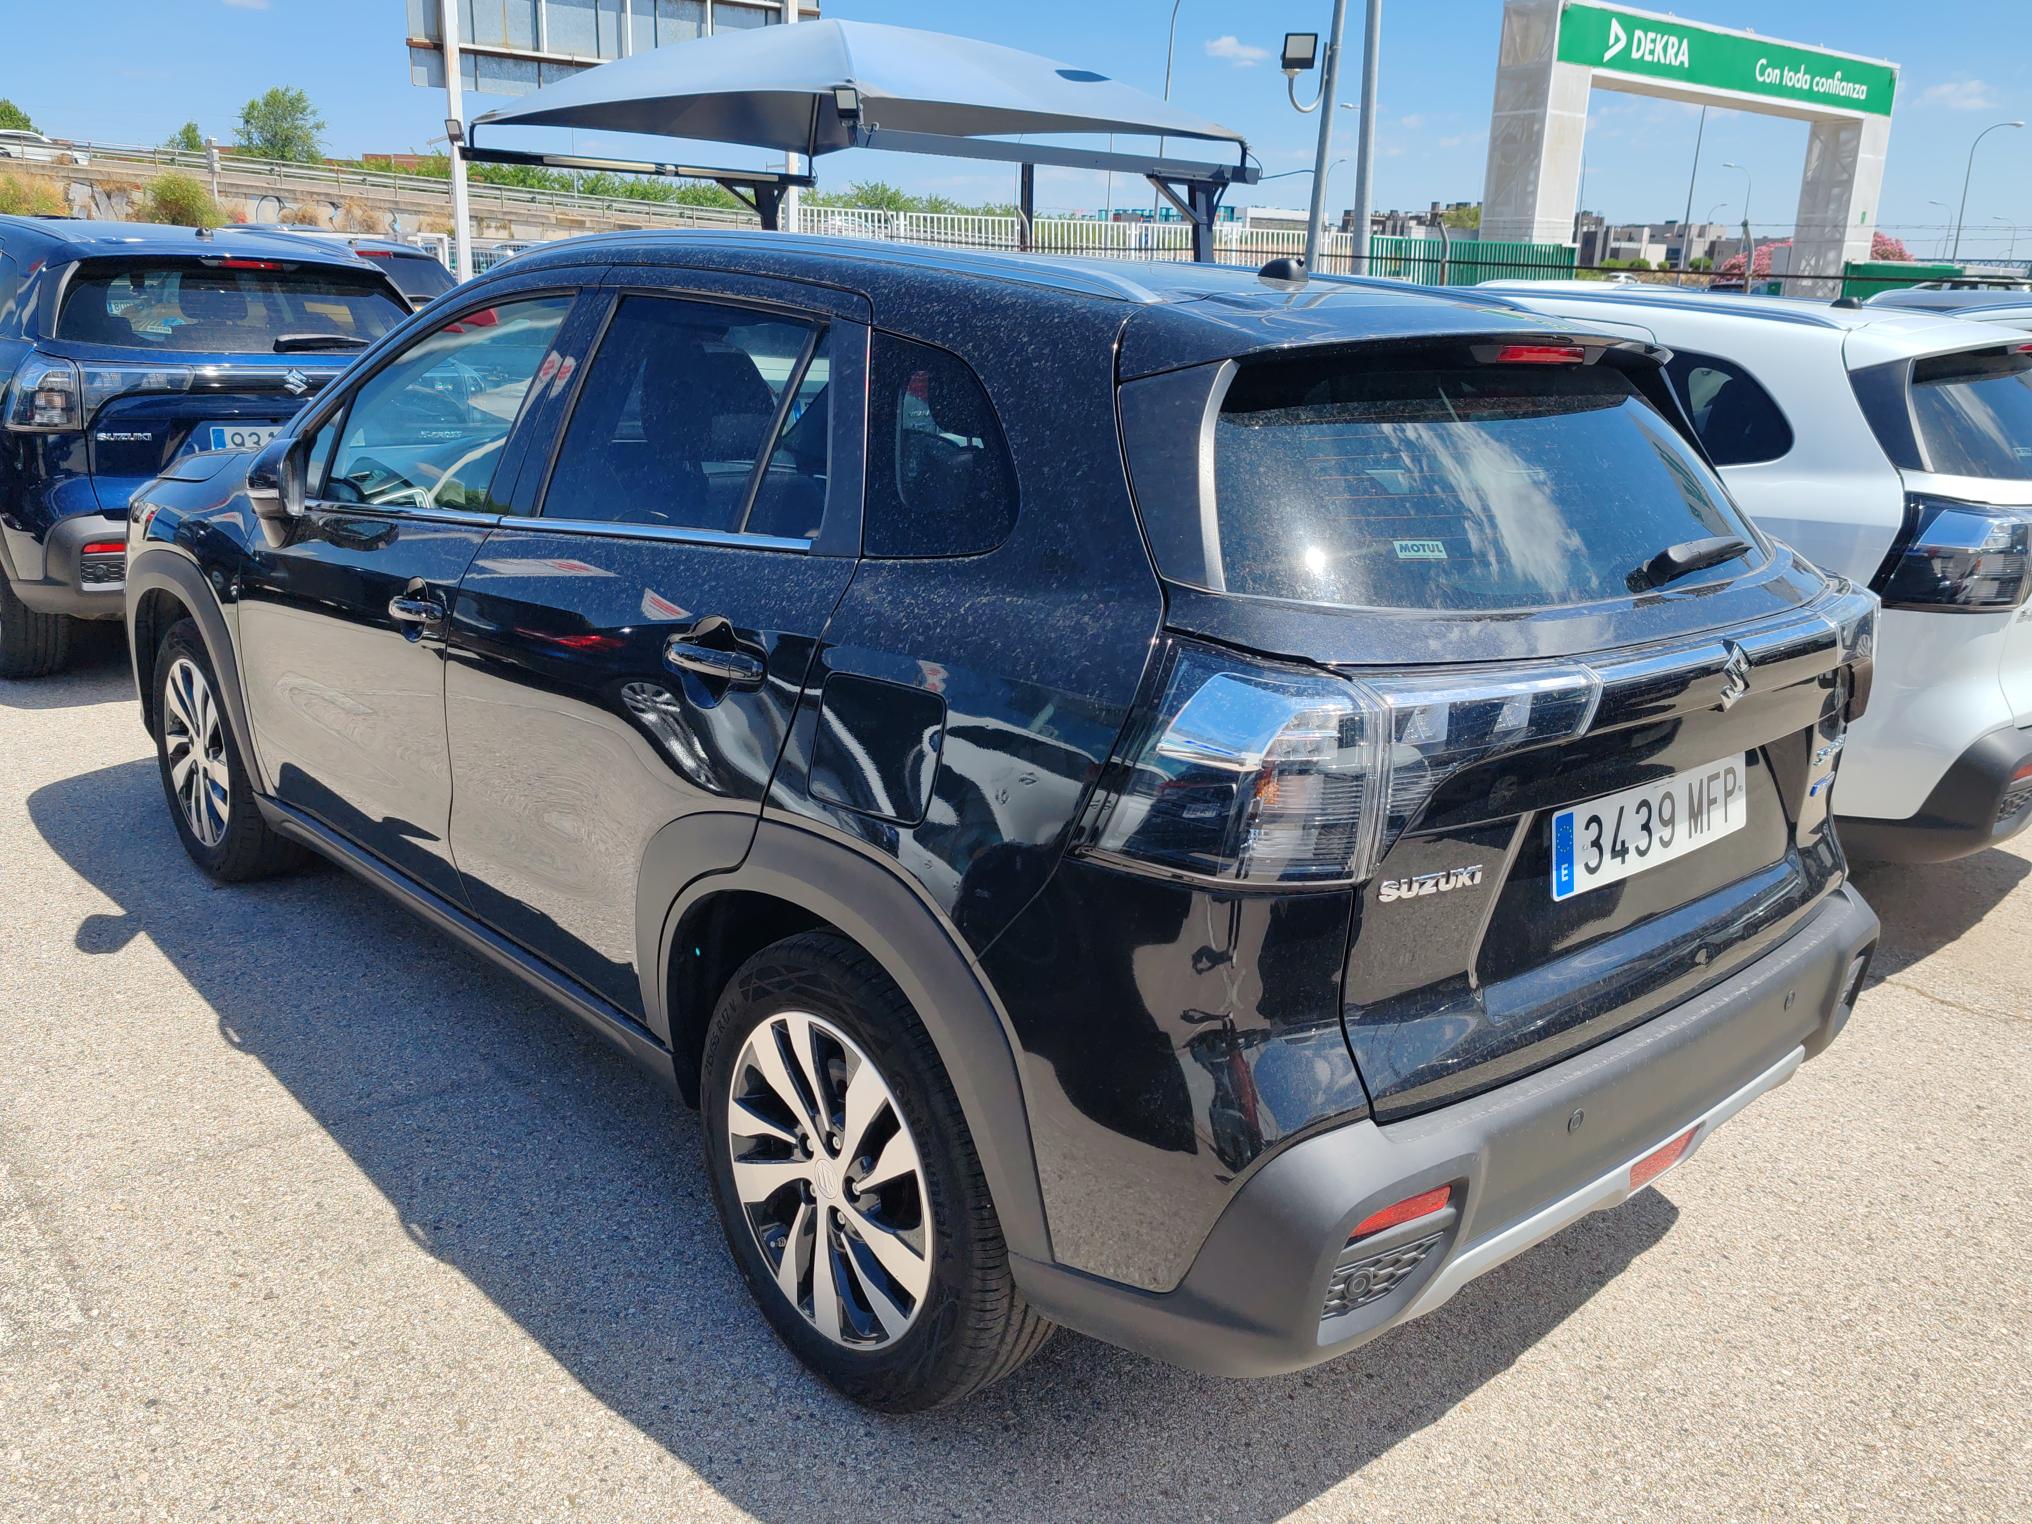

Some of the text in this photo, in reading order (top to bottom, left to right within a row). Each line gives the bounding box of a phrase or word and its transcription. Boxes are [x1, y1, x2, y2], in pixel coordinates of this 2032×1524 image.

[1630, 29, 1689, 68] DEKRA
[1755, 58, 1867, 99] Con toda confianza
[97, 432, 152, 441] SUZUKI
[231, 431, 275, 447] 93
[1399, 543, 1443, 553] MOTUL
[1584, 766, 1737, 875] 3439 MFP
[1378, 864, 1483, 903] SUZUKI
[1561, 863, 1569, 881] E
